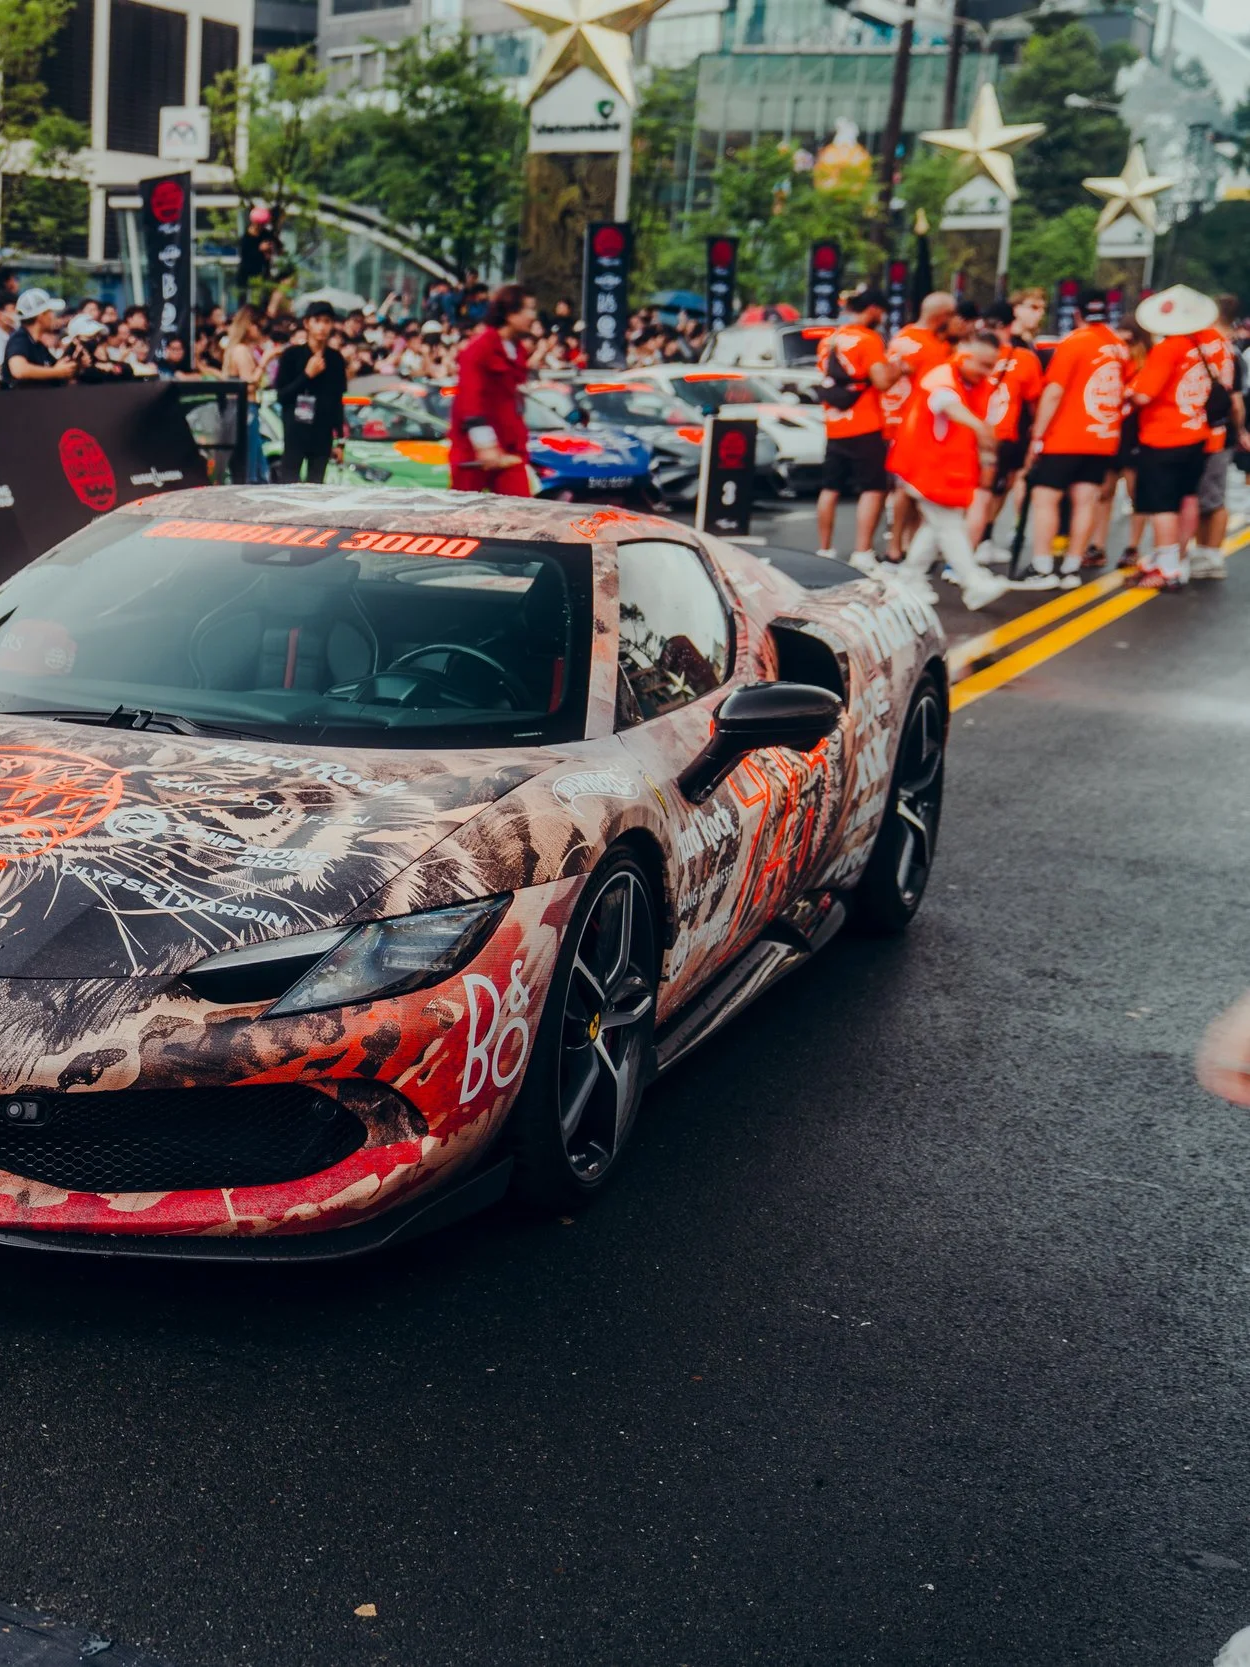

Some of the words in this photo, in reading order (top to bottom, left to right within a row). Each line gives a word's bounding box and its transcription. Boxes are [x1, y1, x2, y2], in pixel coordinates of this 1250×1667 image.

[142, 520, 340, 548] GUMBALL
[338, 532, 481, 559] 3000
[152, 778, 224, 797] BANG
[200, 745, 316, 770] Hard
[307, 762, 408, 797] Rock
[60, 862, 162, 898] ULYSSE
[176, 894, 291, 927] NARDIN
